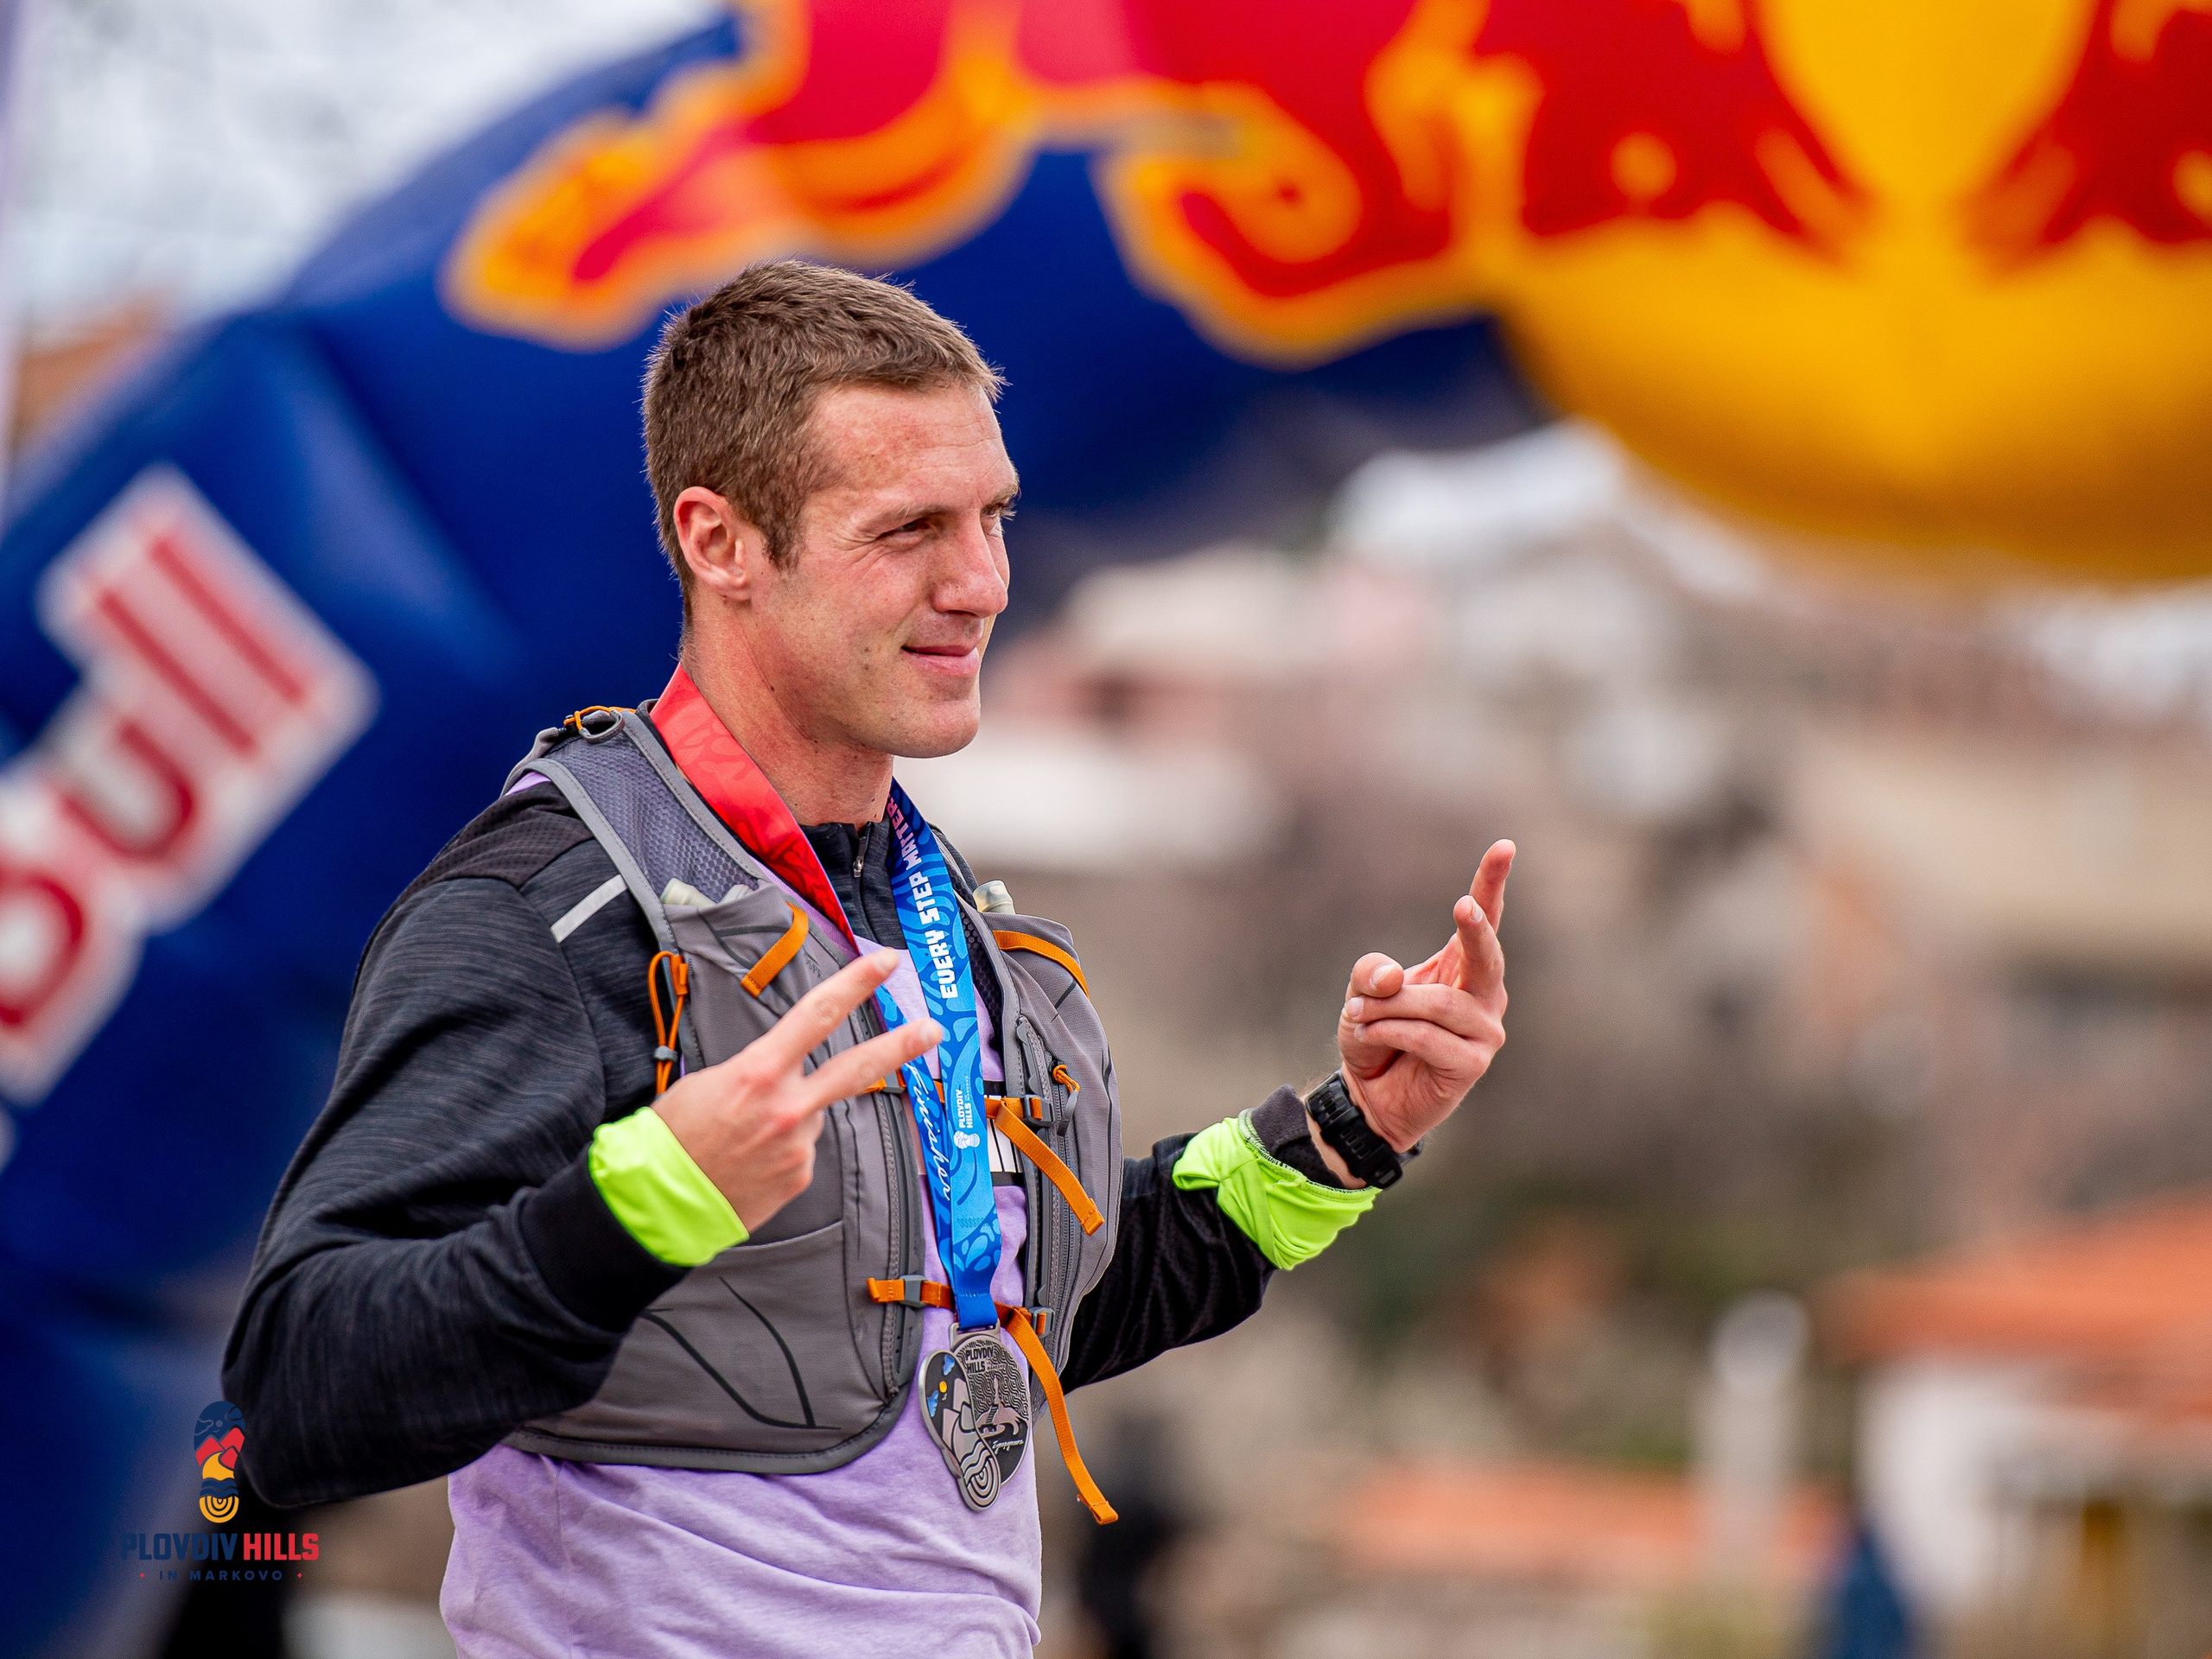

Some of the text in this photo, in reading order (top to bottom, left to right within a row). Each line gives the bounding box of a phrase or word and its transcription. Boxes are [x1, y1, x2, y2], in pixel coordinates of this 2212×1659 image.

[887, 793, 958, 1000] EVERY STEP MATTER
[955, 1089, 966, 1128] PLOVDIV
[963, 1103, 974, 1128] HILLS
[904, 1063, 950, 1202] Finisher
[965, 1346, 994, 1361] PLOVDIV
[966, 1360, 986, 1374] HILLS
